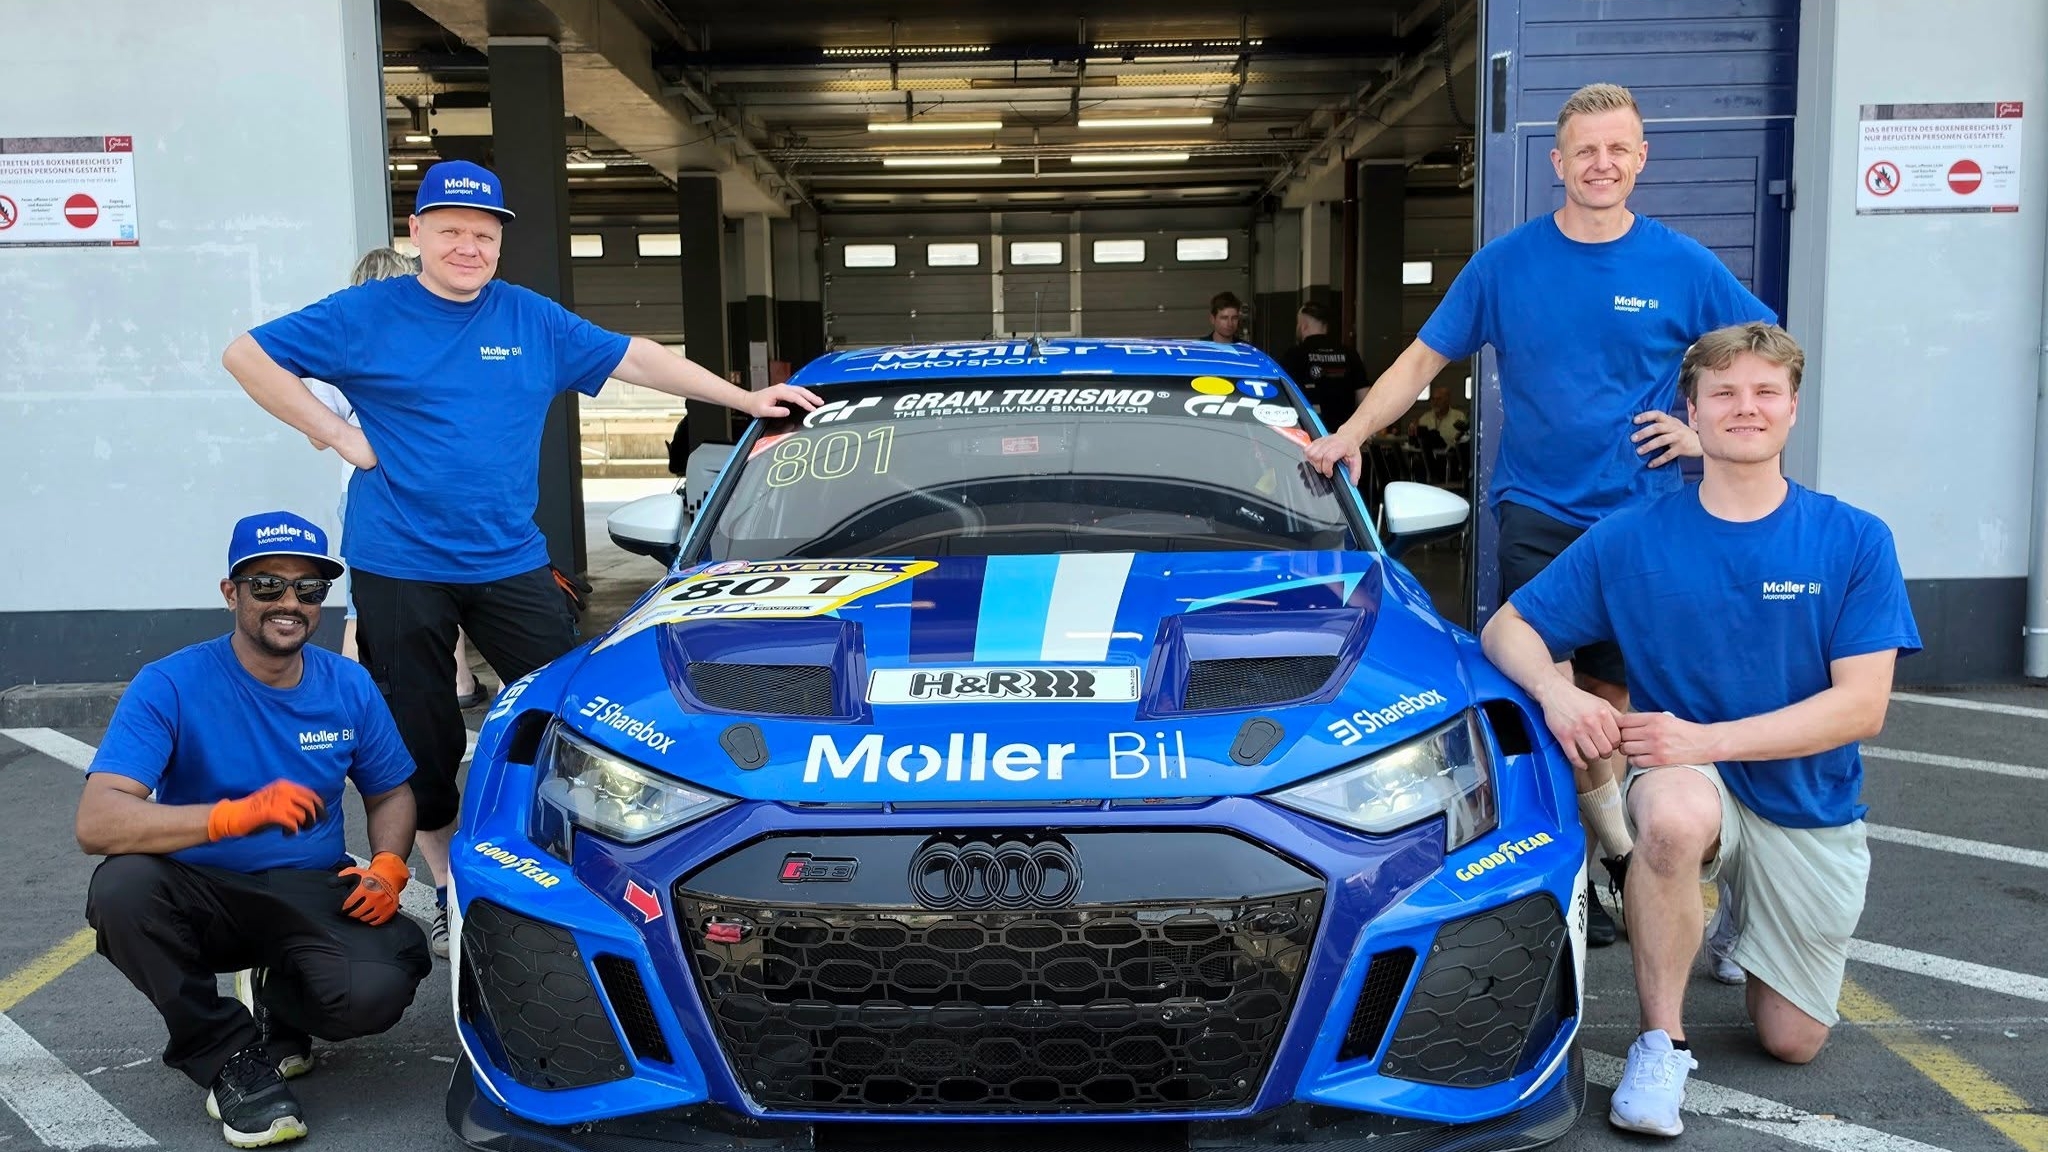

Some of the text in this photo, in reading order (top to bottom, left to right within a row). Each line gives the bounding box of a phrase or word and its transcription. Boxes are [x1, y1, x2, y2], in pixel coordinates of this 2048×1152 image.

[871, 356, 1048, 372] Motorsport
[893, 390, 994, 411] GRAN
[930, 408, 973, 416] REAL
[977, 406, 1047, 414] DRIVING
[1051, 405, 1149, 414] SIMULATOR
[1243, 380, 1269, 397] T
[767, 425, 895, 487] 801
[671, 574, 851, 601] 801
[596, 703, 677, 755] Sharebox
[1352, 688, 1448, 734] Sharebox
[1108, 730, 1187, 780] Bil
[474, 841, 560, 889] GOODYEAR
[1455, 832, 1554, 882] GOODYEAR
